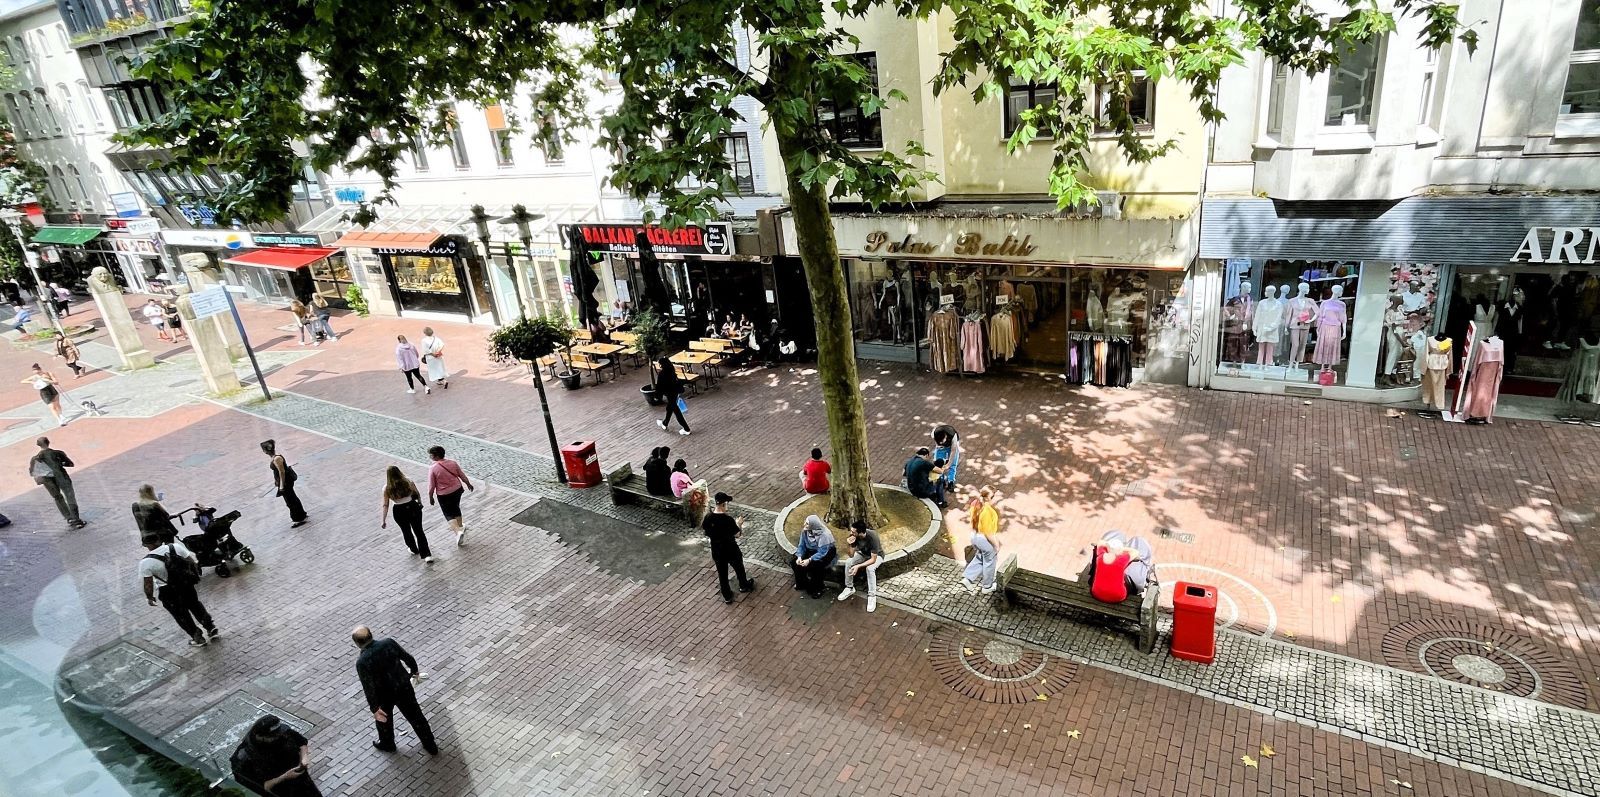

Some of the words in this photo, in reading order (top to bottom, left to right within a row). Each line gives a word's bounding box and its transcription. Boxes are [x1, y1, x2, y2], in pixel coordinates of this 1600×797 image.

[582, 227, 636, 245] BALKAN
[637, 223, 703, 246] ÄCKEREI
[953, 232, 1039, 256] Butik
[609, 244, 632, 252] Balkan
[632, 244, 677, 253] Slitäten
